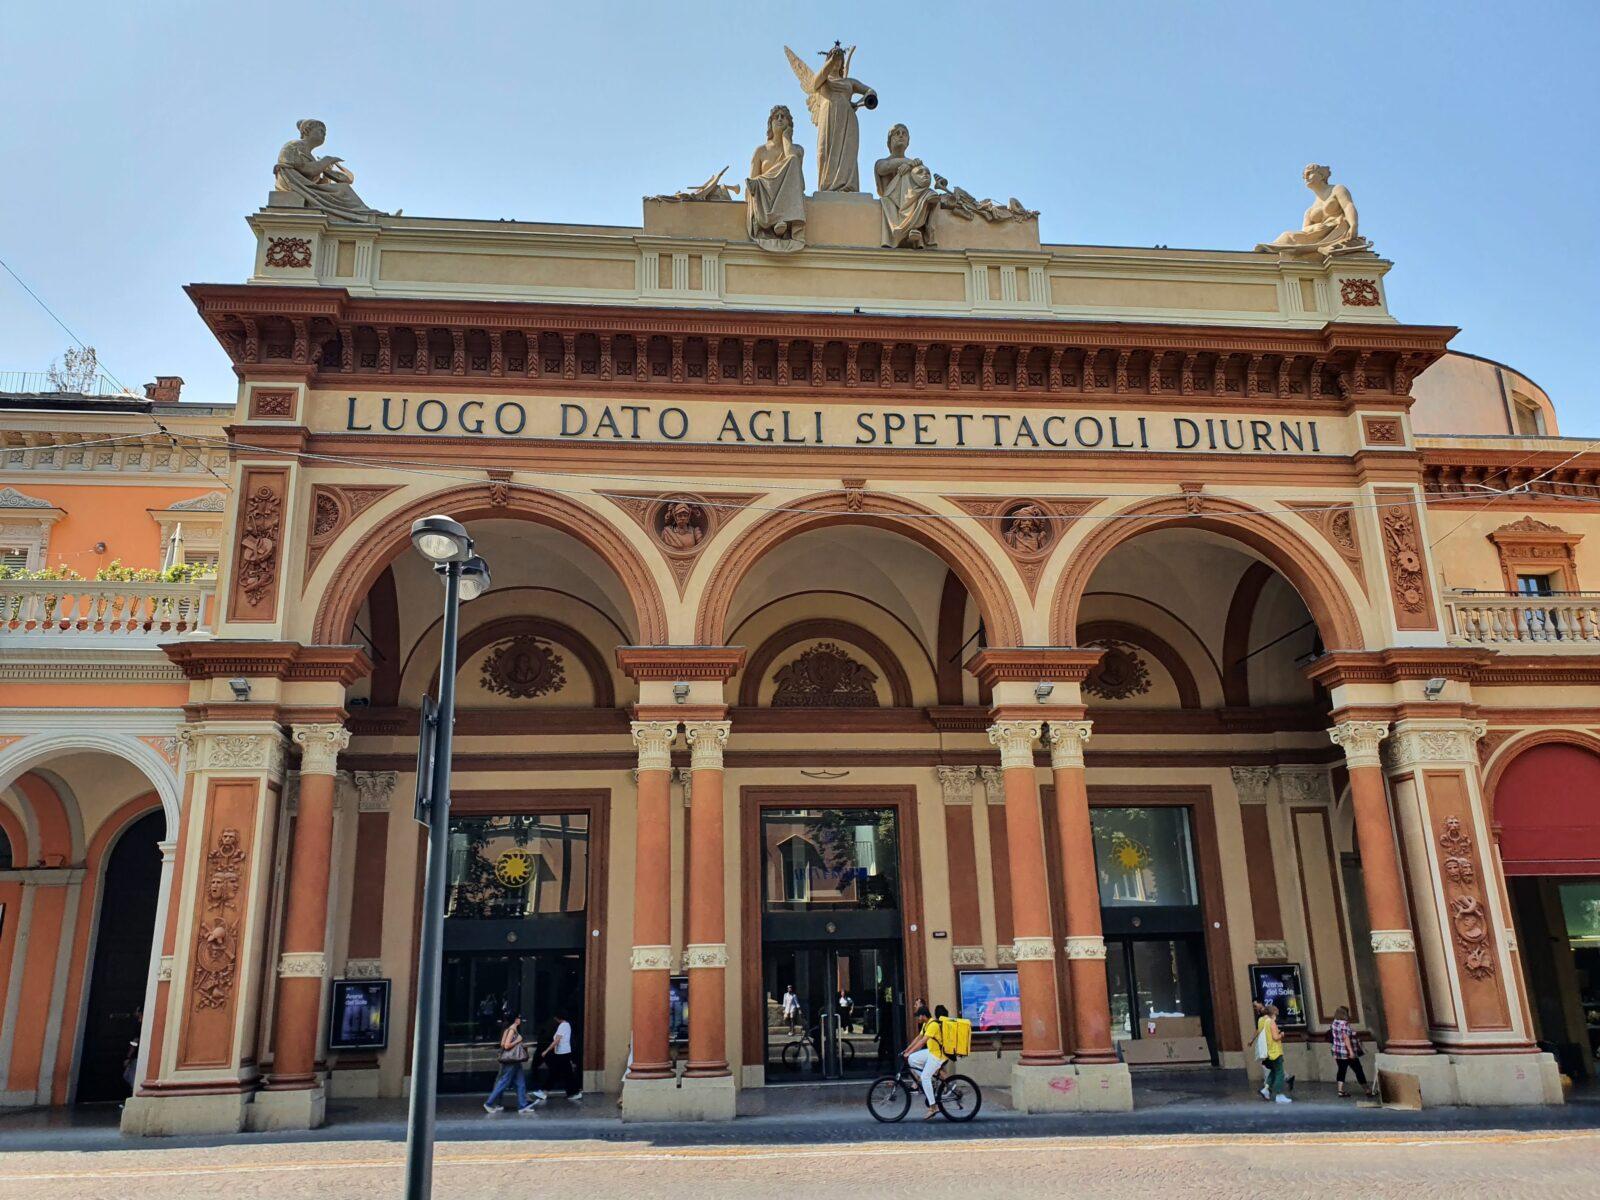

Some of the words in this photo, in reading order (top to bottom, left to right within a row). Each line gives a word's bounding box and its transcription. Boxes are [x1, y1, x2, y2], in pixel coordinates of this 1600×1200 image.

[346, 397, 527, 436] LUOGO
[559, 403, 689, 440] DATO
[716, 409, 824, 444] AGLI
[855, 412, 1149, 449] SPETTACOLI
[1173, 418, 1320, 453] DIURNI
